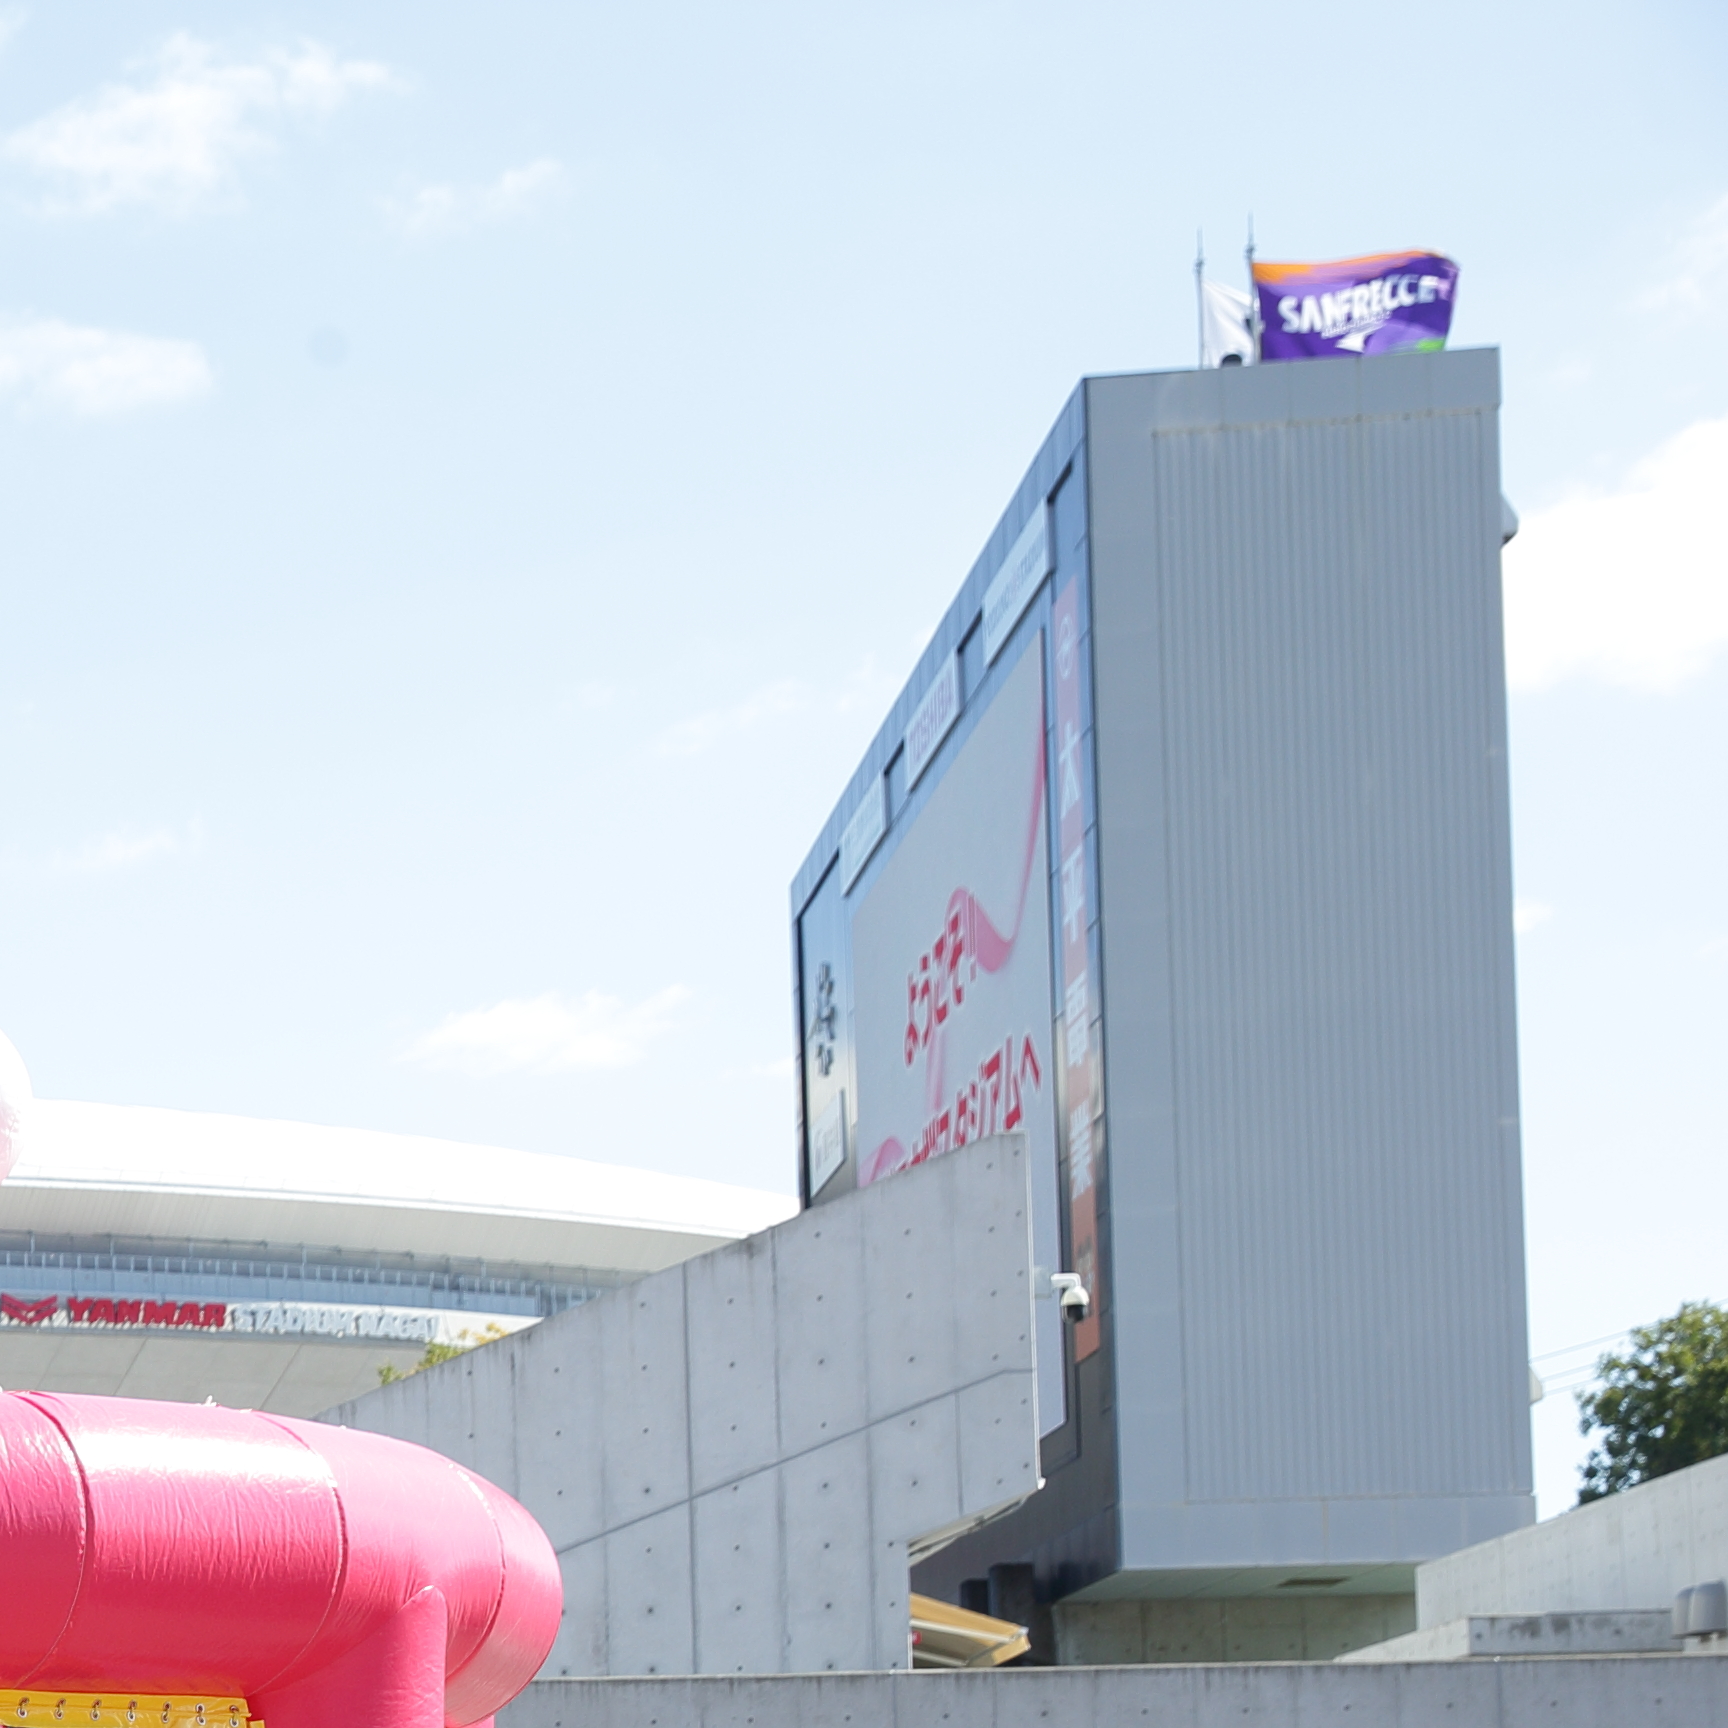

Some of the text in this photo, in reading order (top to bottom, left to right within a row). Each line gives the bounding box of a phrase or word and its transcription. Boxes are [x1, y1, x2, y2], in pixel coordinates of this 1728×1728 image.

[1278, 274, 1440, 334] SANFRECCE
[66, 1296, 441, 1339] YANMAR STADIUM NAGAI
